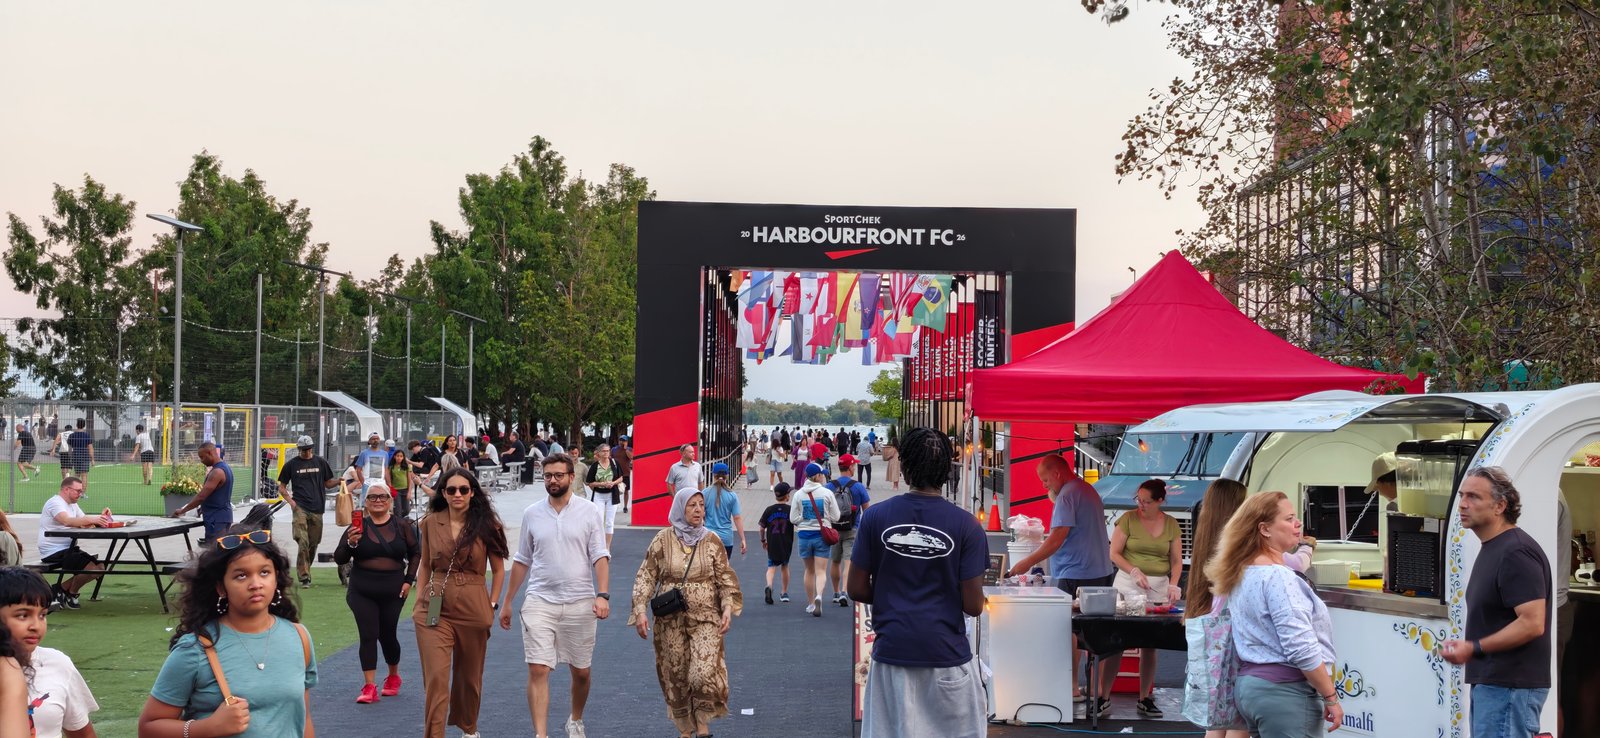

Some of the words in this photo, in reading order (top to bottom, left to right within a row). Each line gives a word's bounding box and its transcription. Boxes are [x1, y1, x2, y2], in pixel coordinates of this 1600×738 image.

[824, 214, 881, 224] SPORTCHEK
[753, 226, 925, 245] HARBOURFRONT
[930, 228, 954, 246] FC
[956, 233, 966, 241] 26
[1341, 711, 1374, 732] malfi
